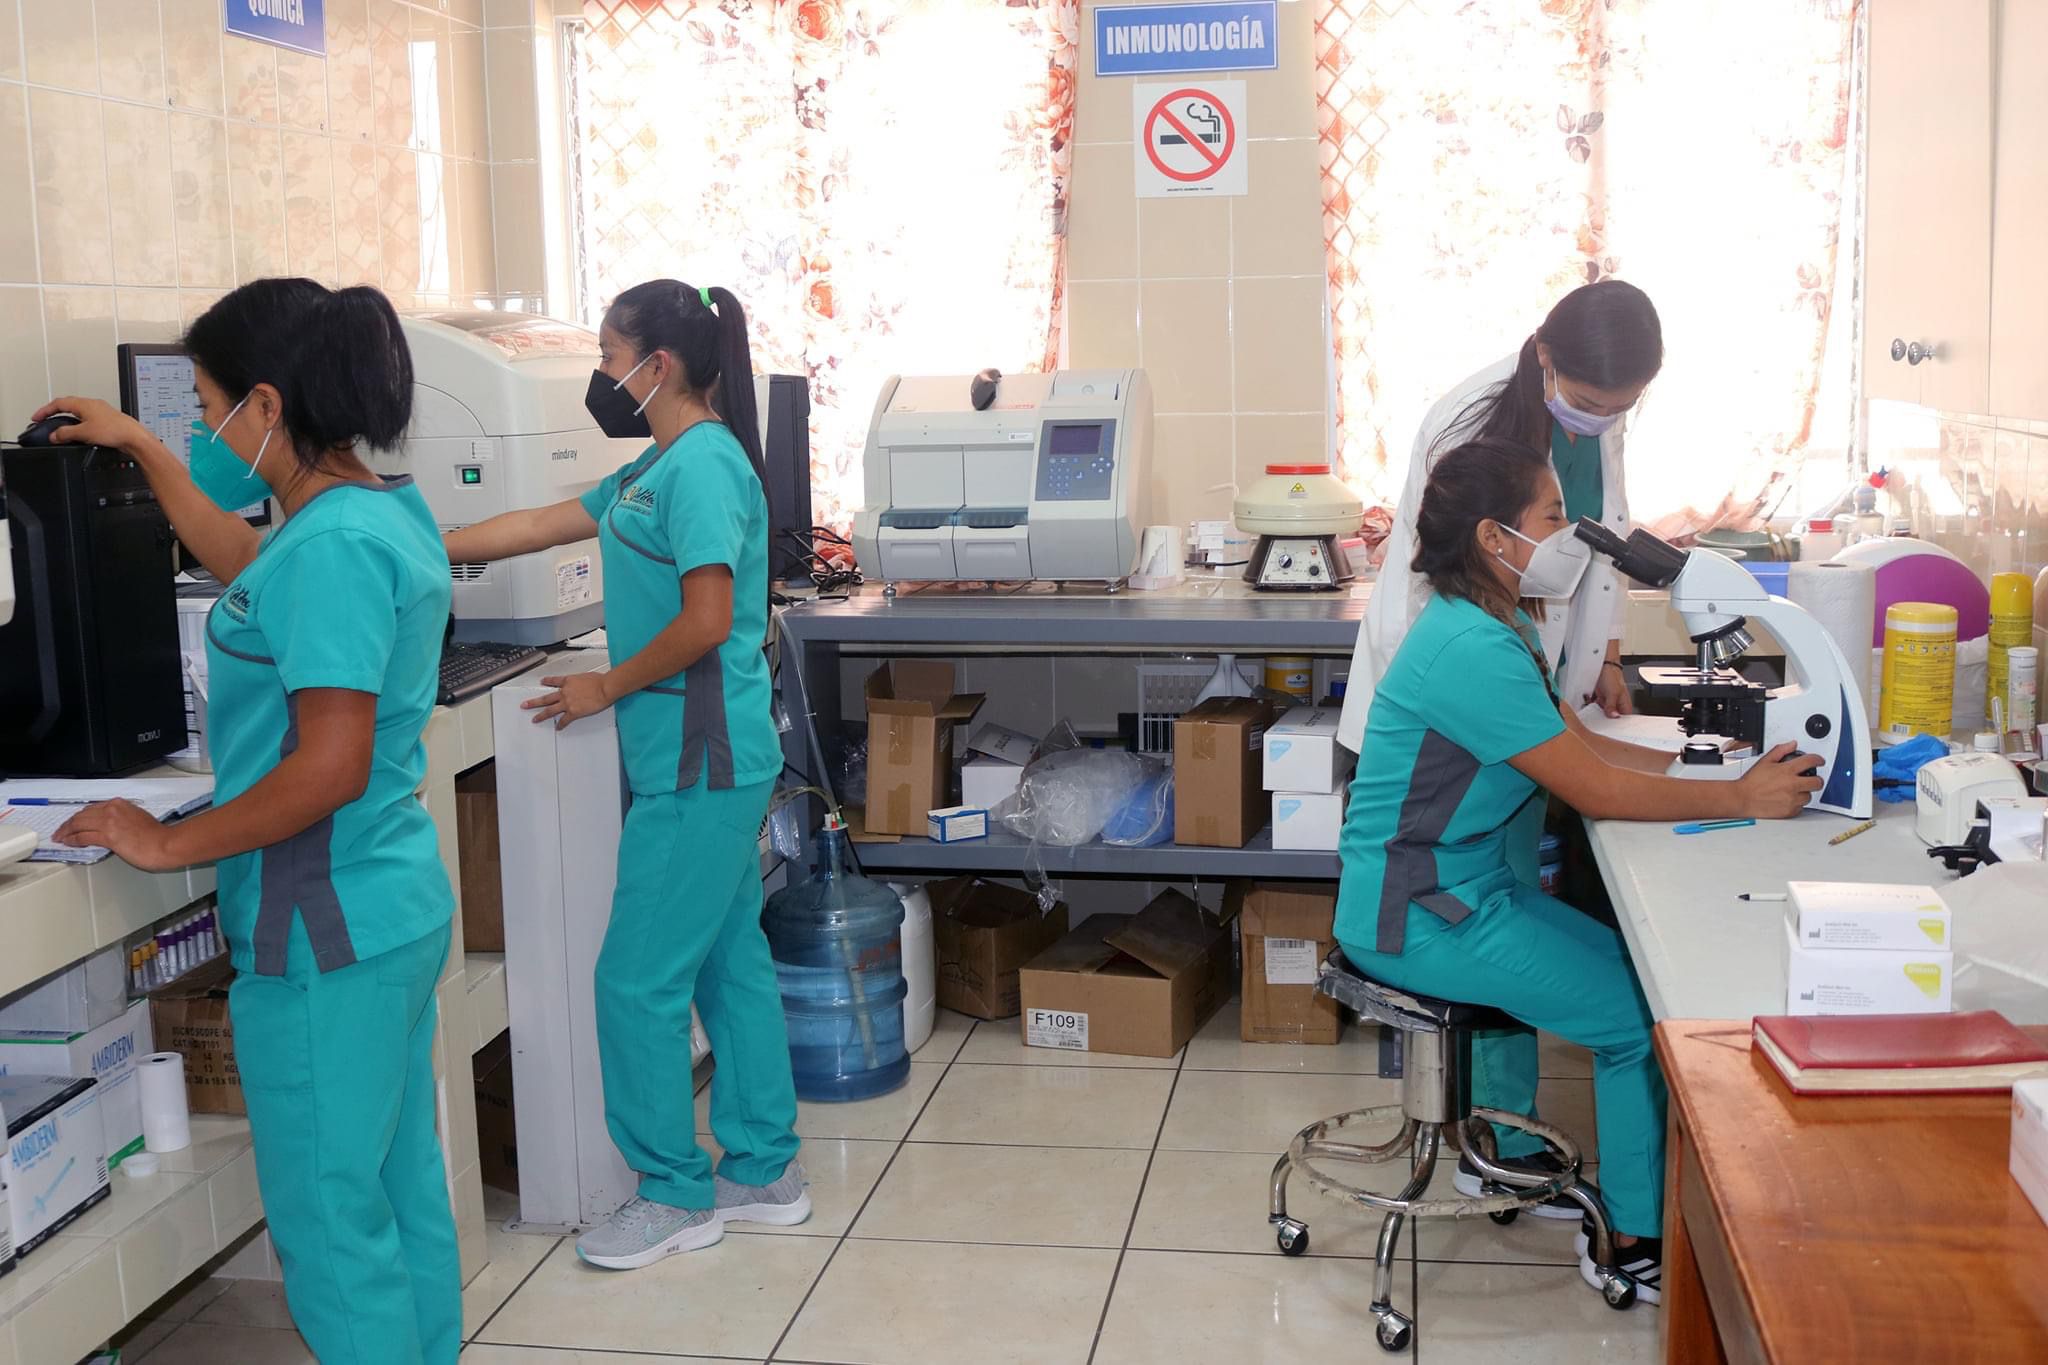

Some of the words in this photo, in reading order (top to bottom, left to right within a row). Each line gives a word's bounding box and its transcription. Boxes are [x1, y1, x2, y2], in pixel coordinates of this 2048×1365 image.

[1106, 15, 1265, 55] INMUNOLOGÍA
[1035, 1012, 1075, 1028] F109
[91, 1031, 134, 1074] AMBIDERM
